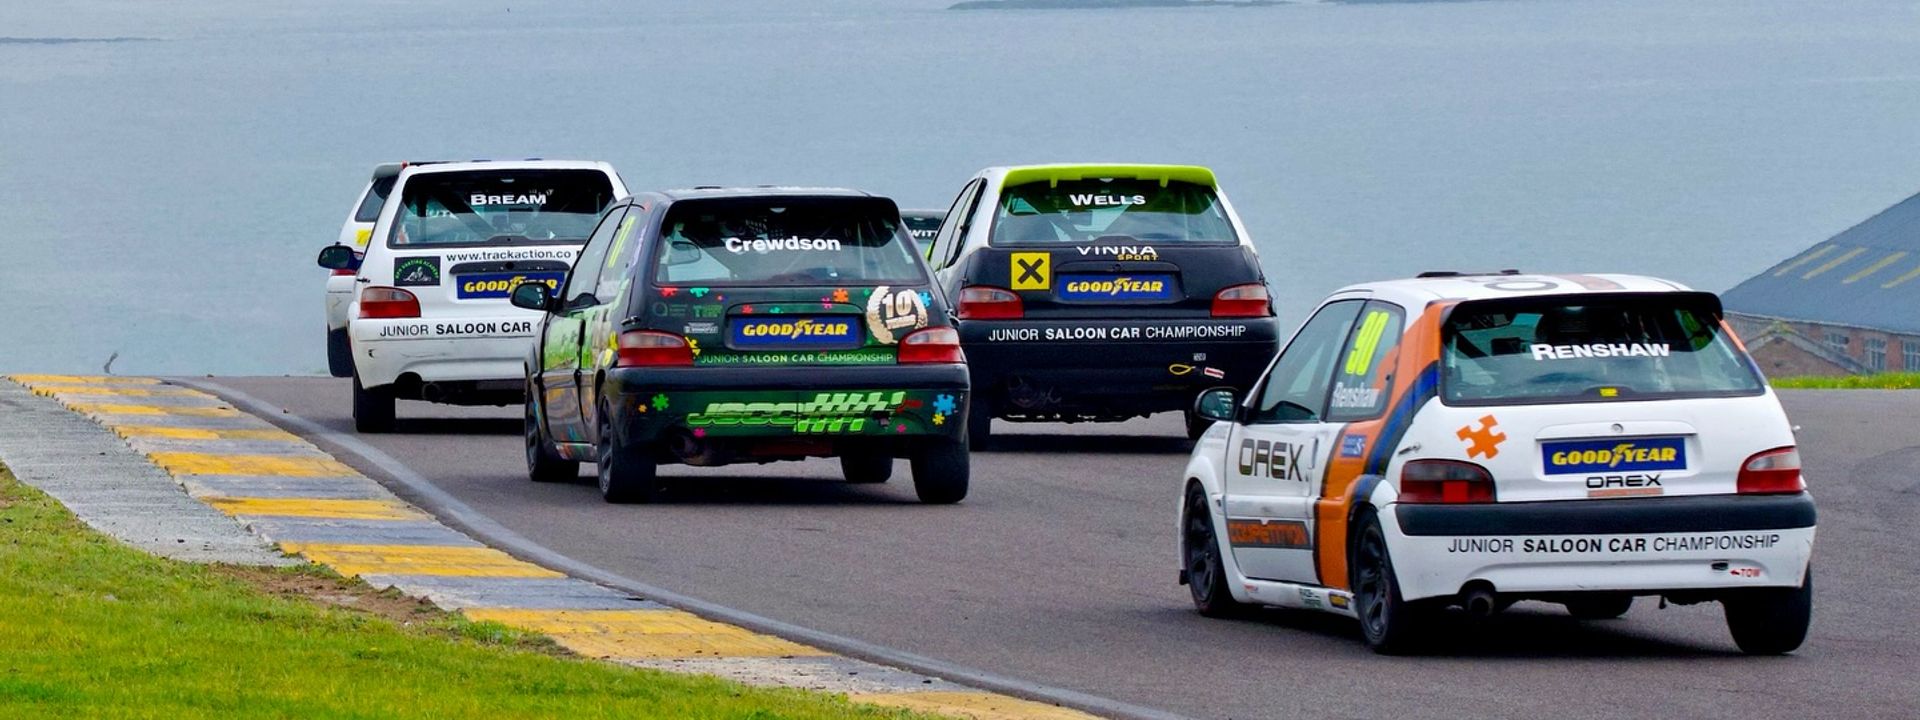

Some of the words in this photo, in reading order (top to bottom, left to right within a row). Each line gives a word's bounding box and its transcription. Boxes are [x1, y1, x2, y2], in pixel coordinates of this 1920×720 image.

[470, 194, 547, 206] BREAM
[1069, 194, 1146, 206] WELLS
[725, 236, 841, 252] Crewdson
[1076, 246, 1157, 256] VINNA
[446, 249, 571, 261] www.trackaction.co
[464, 277, 557, 293] GOODR
[1067, 279, 1163, 294] GOODYEAR
[881, 290, 912, 318] 10
[380, 324, 429, 337] JUNIOR
[436, 322, 496, 335] SALOON
[501, 322, 531, 333] CAR
[743, 321, 849, 338] GOODYEAR
[988, 328, 1039, 341] JUNIOR
[1045, 327, 1106, 340] SALOON
[1110, 327, 1140, 339] CAR
[1145, 325, 1247, 338] CHAMPIONSHIP
[701, 355, 739, 364] JUNIOR
[742, 354, 788, 363] SALOON
[791, 354, 815, 362] CAR
[818, 353, 893, 363] CHAMPIONSHIP
[1530, 343, 1670, 361] RENSHAW
[1552, 445, 1677, 466] GOODYEAR
[1586, 474, 1662, 488] OREX
[1448, 538, 1514, 553] JUNIOR
[1523, 538, 1601, 553] SALOON
[1608, 537, 1647, 552] CAR
[1653, 534, 1781, 551] CHAMPIONSHIP
[1740, 568, 1760, 578] TOW
